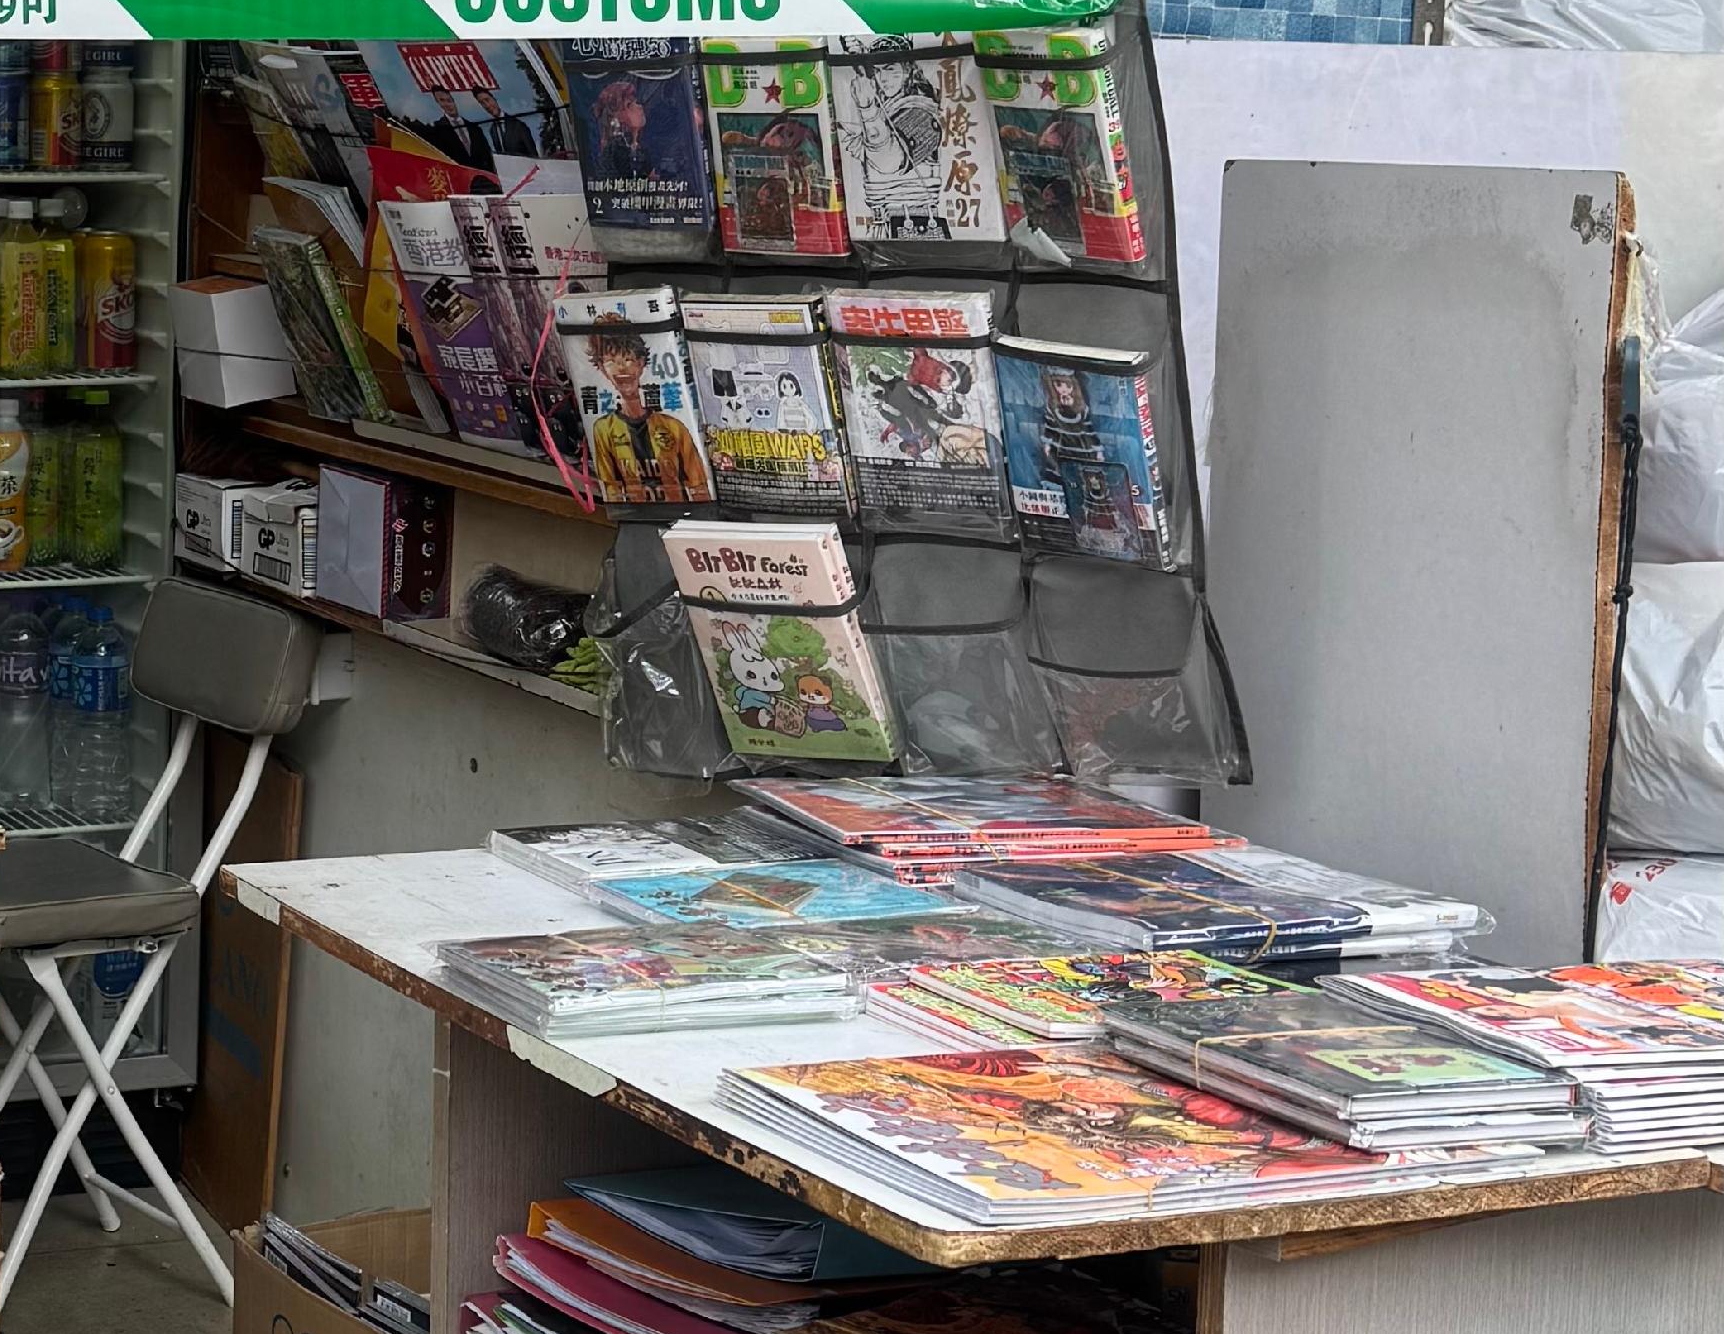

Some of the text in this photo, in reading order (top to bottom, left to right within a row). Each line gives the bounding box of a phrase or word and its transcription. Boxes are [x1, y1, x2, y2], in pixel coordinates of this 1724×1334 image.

[702, 40, 825, 109] D B
[1049, 33, 1098, 107] B
[591, 197, 605, 215] 2
[955, 198, 982, 228] 27
[651, 351, 678, 380] 40
[185, 508, 201, 530] GP
[257, 527, 276, 550] GP
